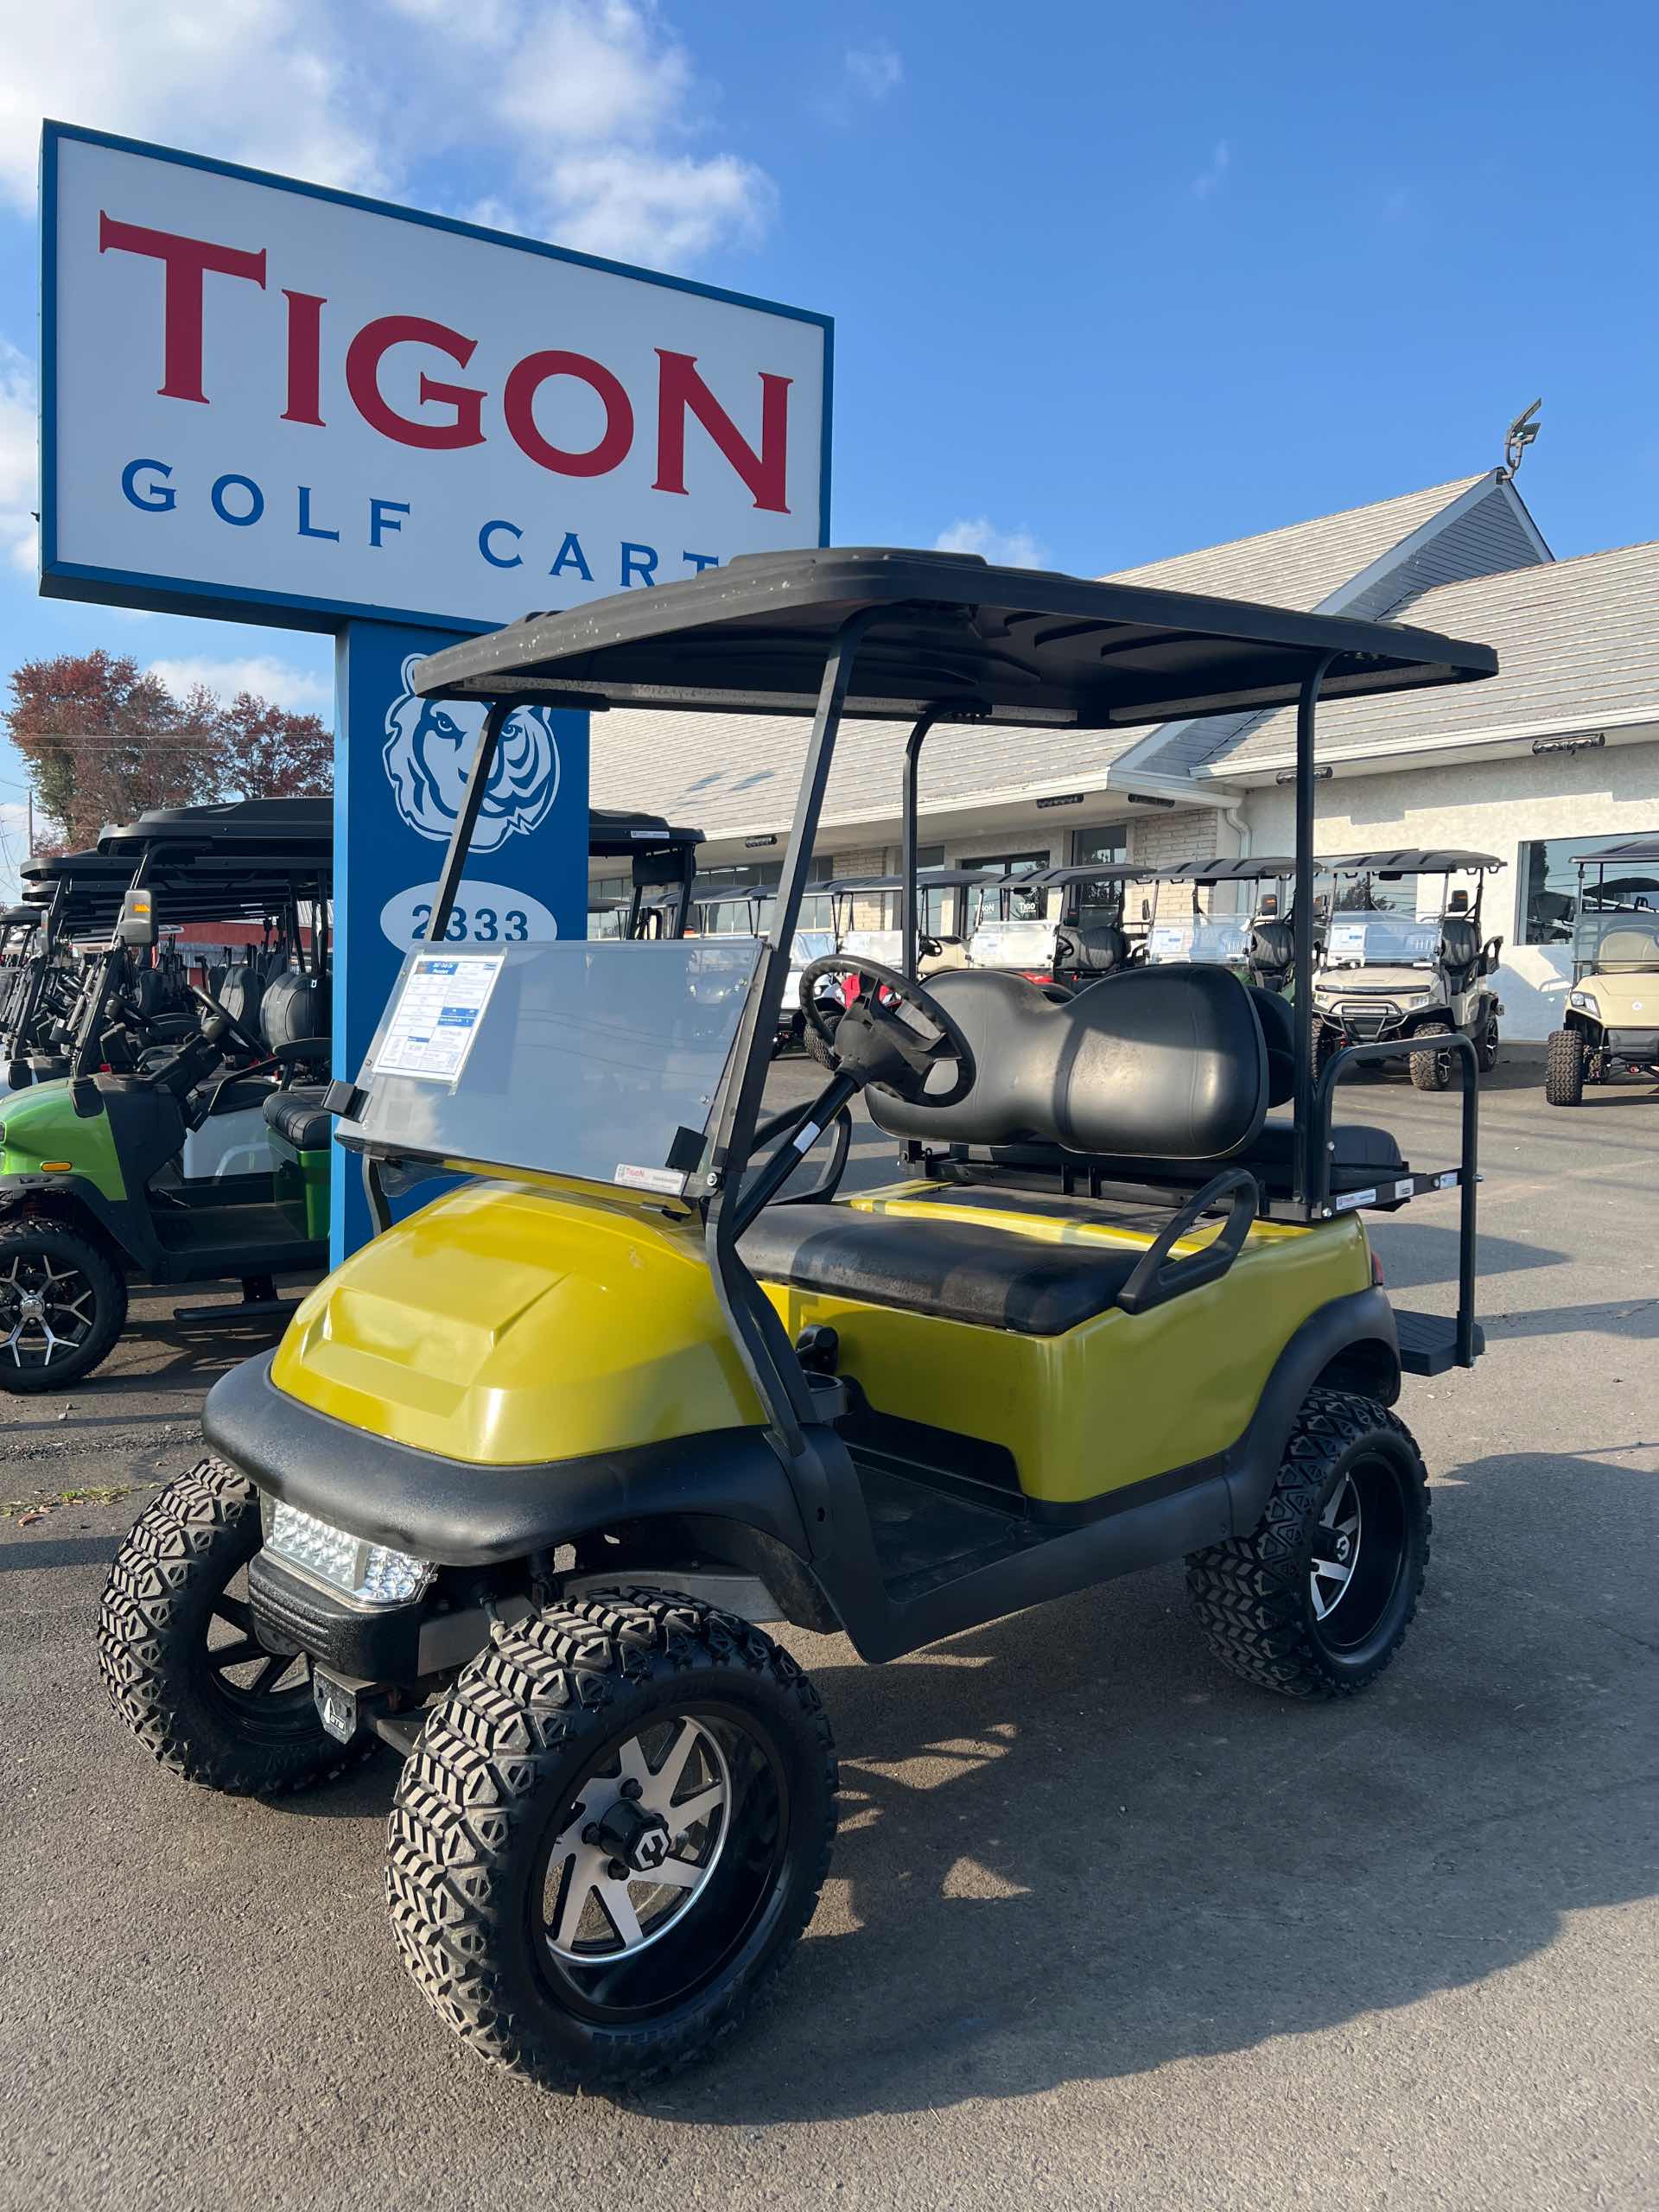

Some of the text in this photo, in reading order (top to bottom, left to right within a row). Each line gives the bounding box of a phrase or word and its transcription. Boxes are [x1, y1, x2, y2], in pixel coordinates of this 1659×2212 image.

[99, 209, 794, 514] TIGON
[121, 458, 720, 588] GOLF CART
[411, 904, 529, 942] 2333
